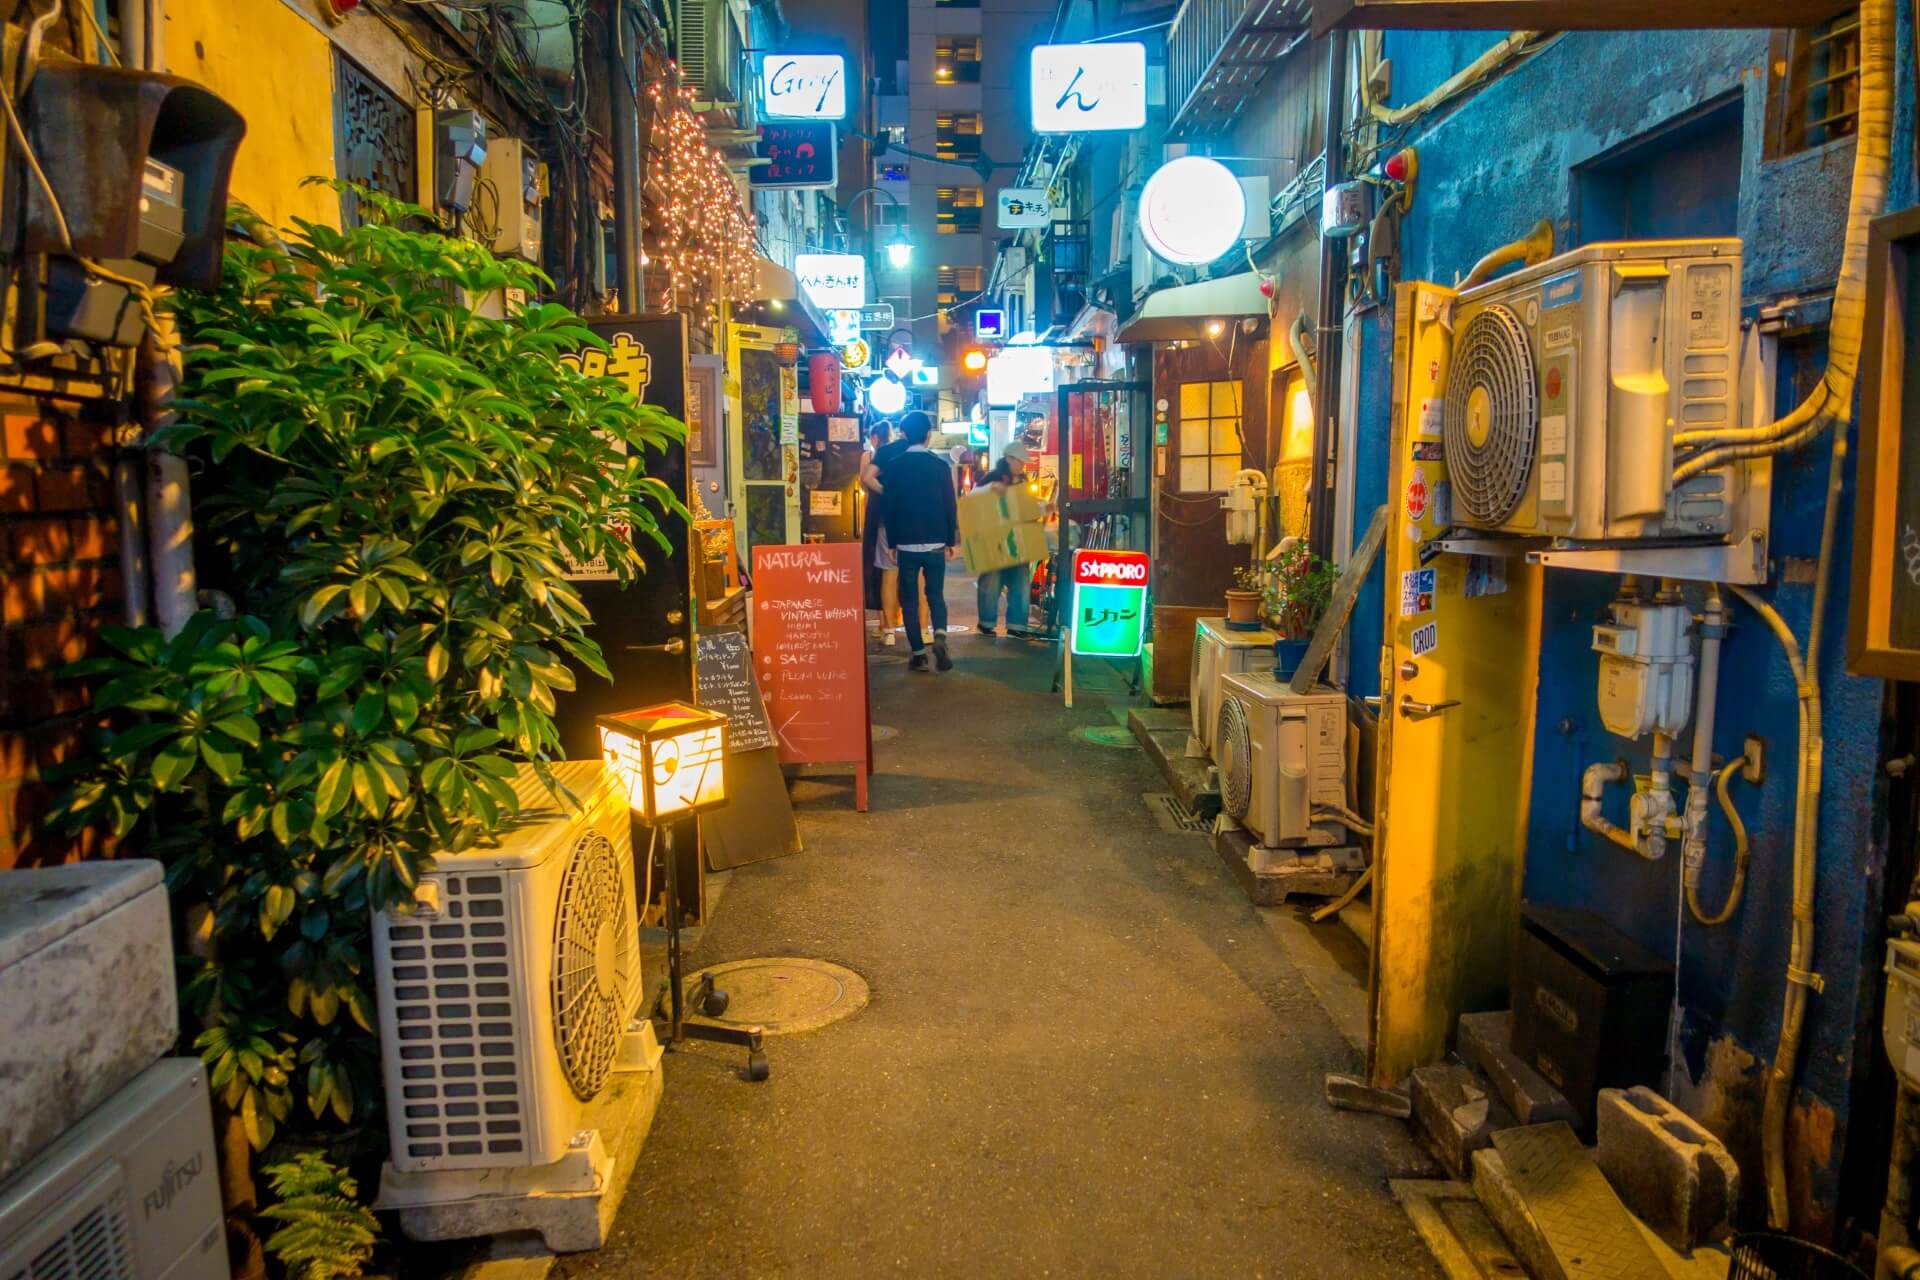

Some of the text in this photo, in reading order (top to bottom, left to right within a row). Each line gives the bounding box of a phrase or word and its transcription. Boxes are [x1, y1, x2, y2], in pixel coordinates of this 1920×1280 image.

[758, 550, 831, 570] NATURAL
[806, 569, 852, 584] WINE
[1080, 560, 1146, 579] SAPPORO
[771, 599, 824, 610] JAPANESE
[780, 611, 823, 621] VINTAGE
[1412, 624, 1437, 655] CROD
[780, 653, 817, 665] SAKE
[143, 1150, 203, 1222] FUJITSU
